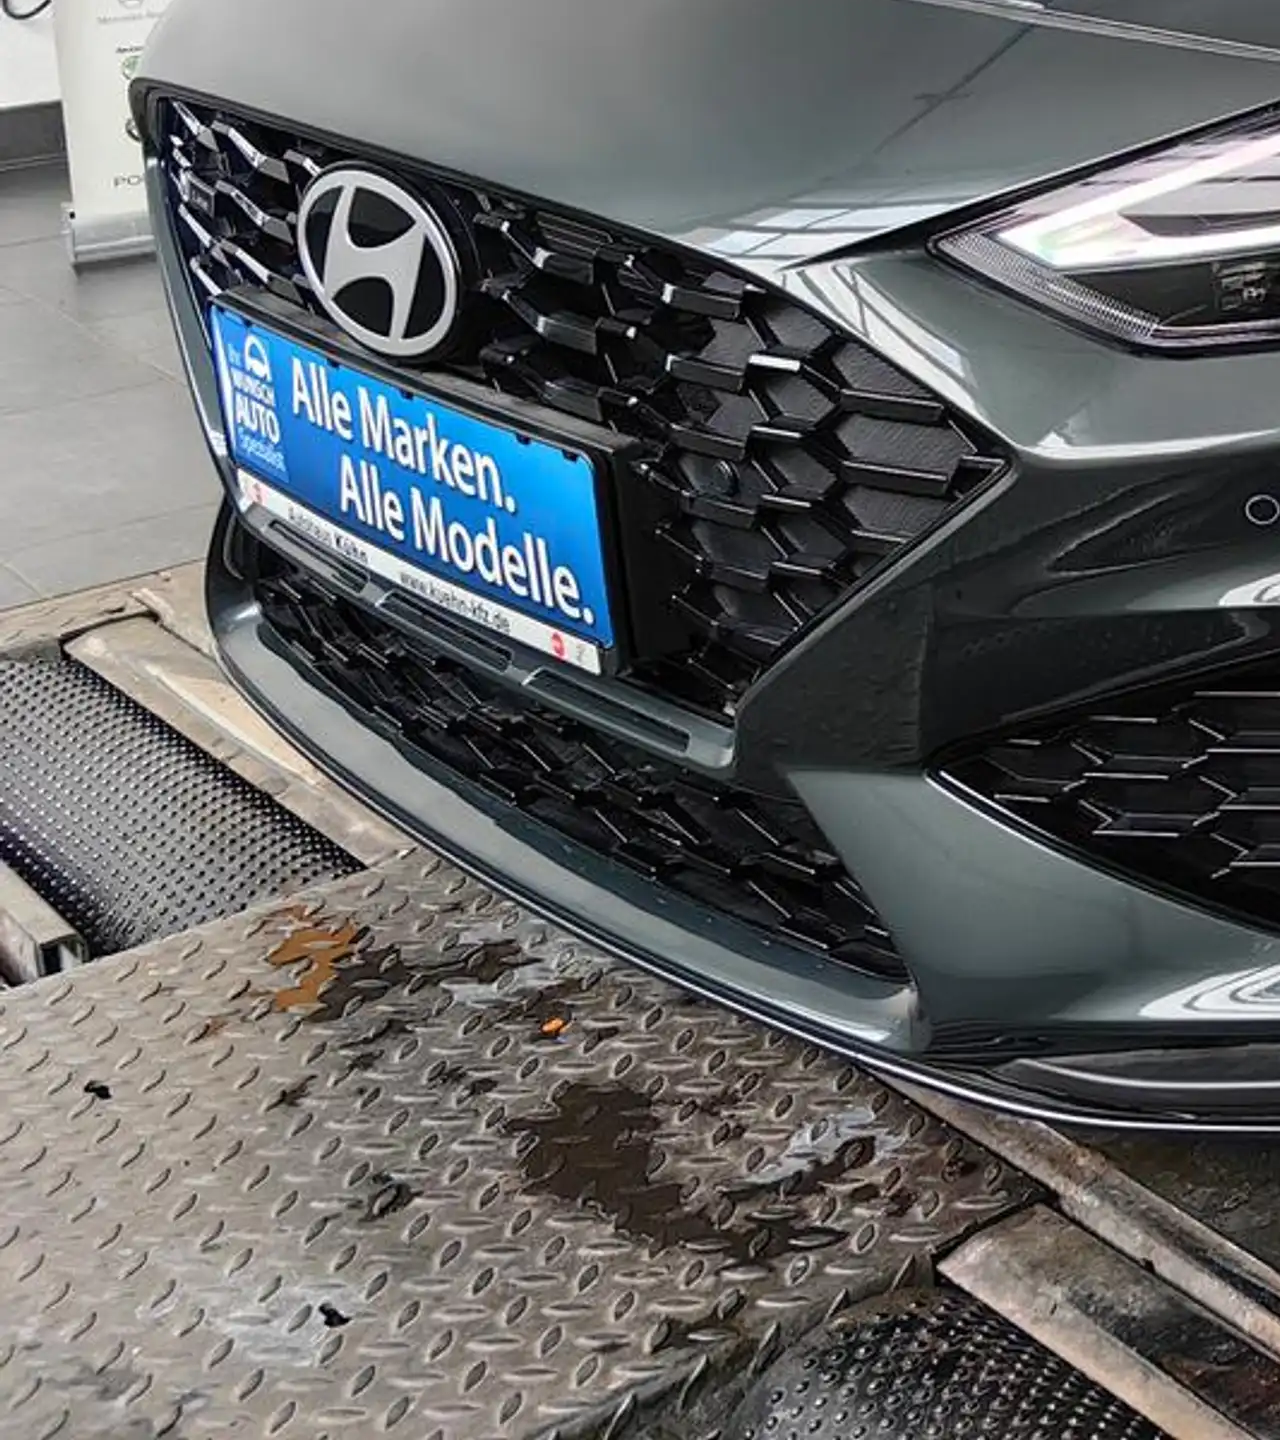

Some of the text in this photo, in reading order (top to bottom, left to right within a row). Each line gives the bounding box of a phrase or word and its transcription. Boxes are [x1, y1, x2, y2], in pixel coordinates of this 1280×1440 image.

[234, 392, 281, 445] AUTO
[291, 356, 353, 442] Alle
[359, 385, 517, 514] Marken.
[339, 454, 596, 625] Alle Modelle.
